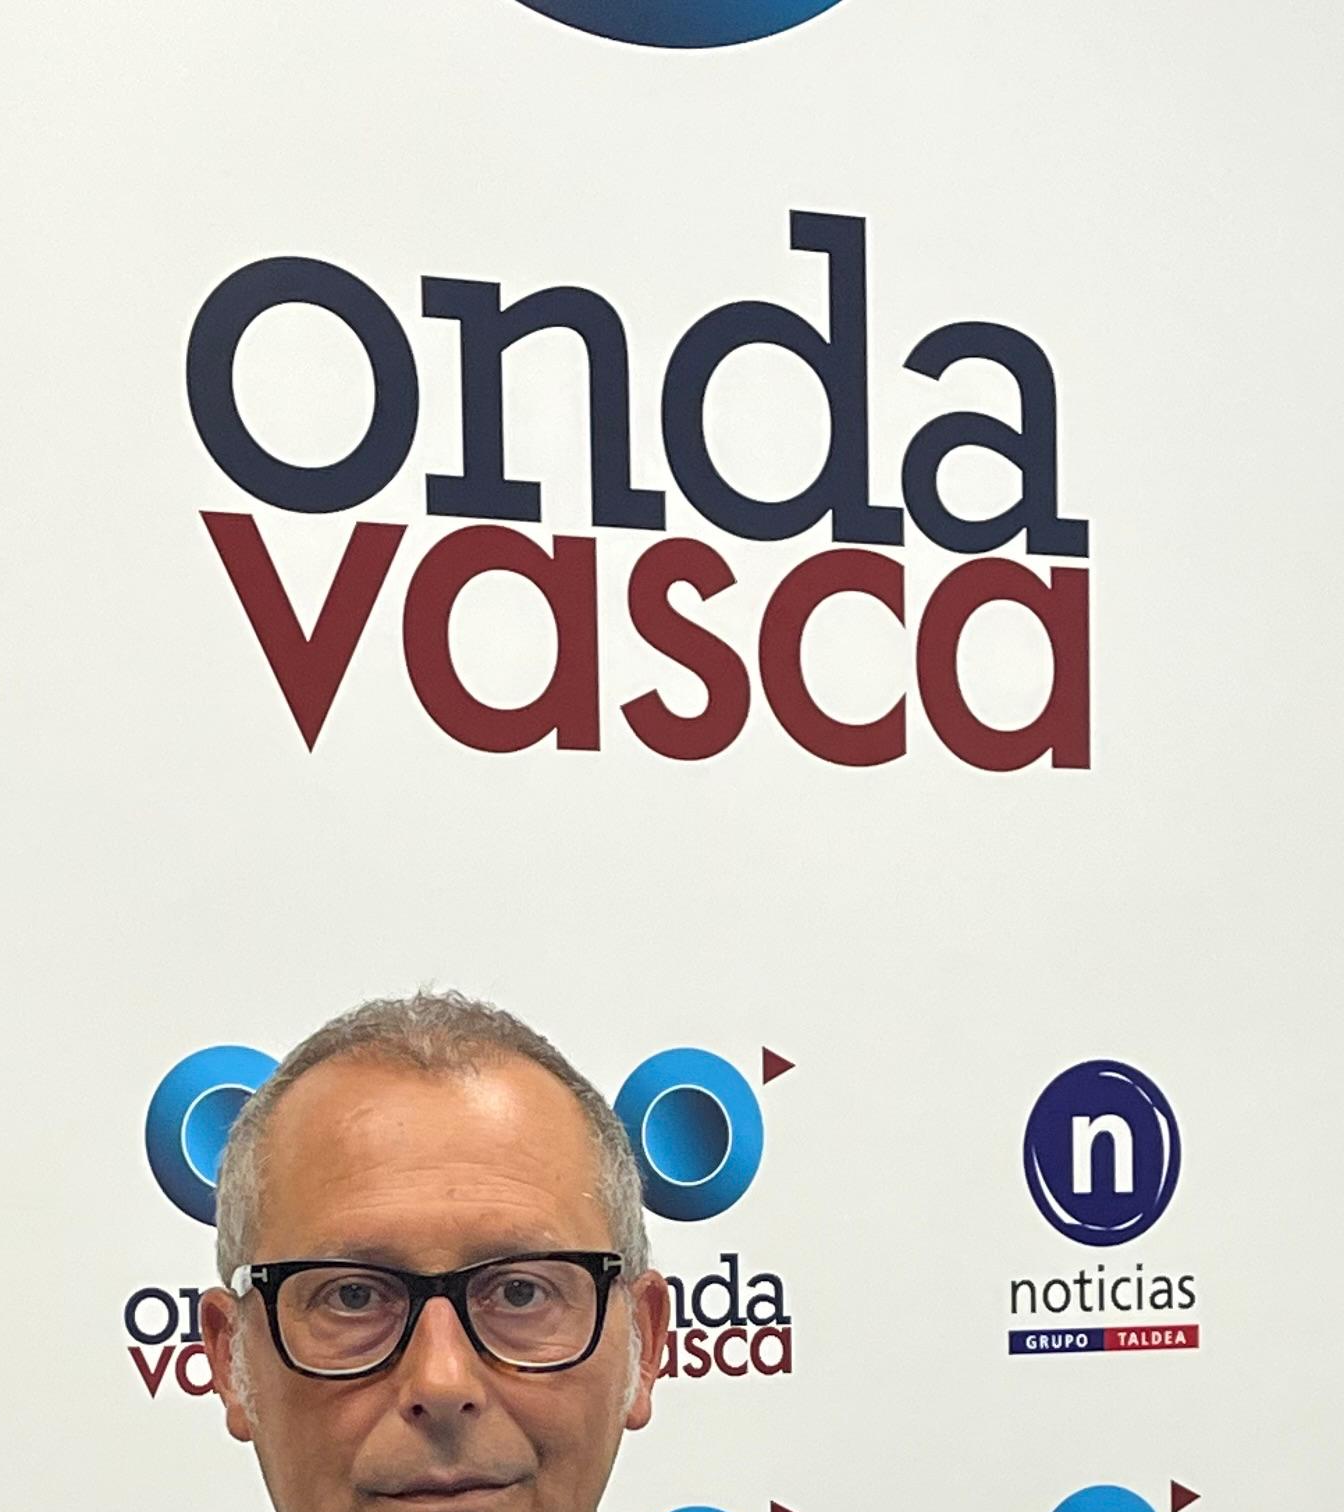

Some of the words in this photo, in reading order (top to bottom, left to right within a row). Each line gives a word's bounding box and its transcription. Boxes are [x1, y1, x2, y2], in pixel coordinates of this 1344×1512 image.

[186, 209, 1089, 558] onda
[199, 511, 1090, 772] vasca
[1010, 1263, 1196, 1314] noticias
[1025, 1333, 1089, 1350] GRUPO
[1117, 1330, 1187, 1346] TALDEA
